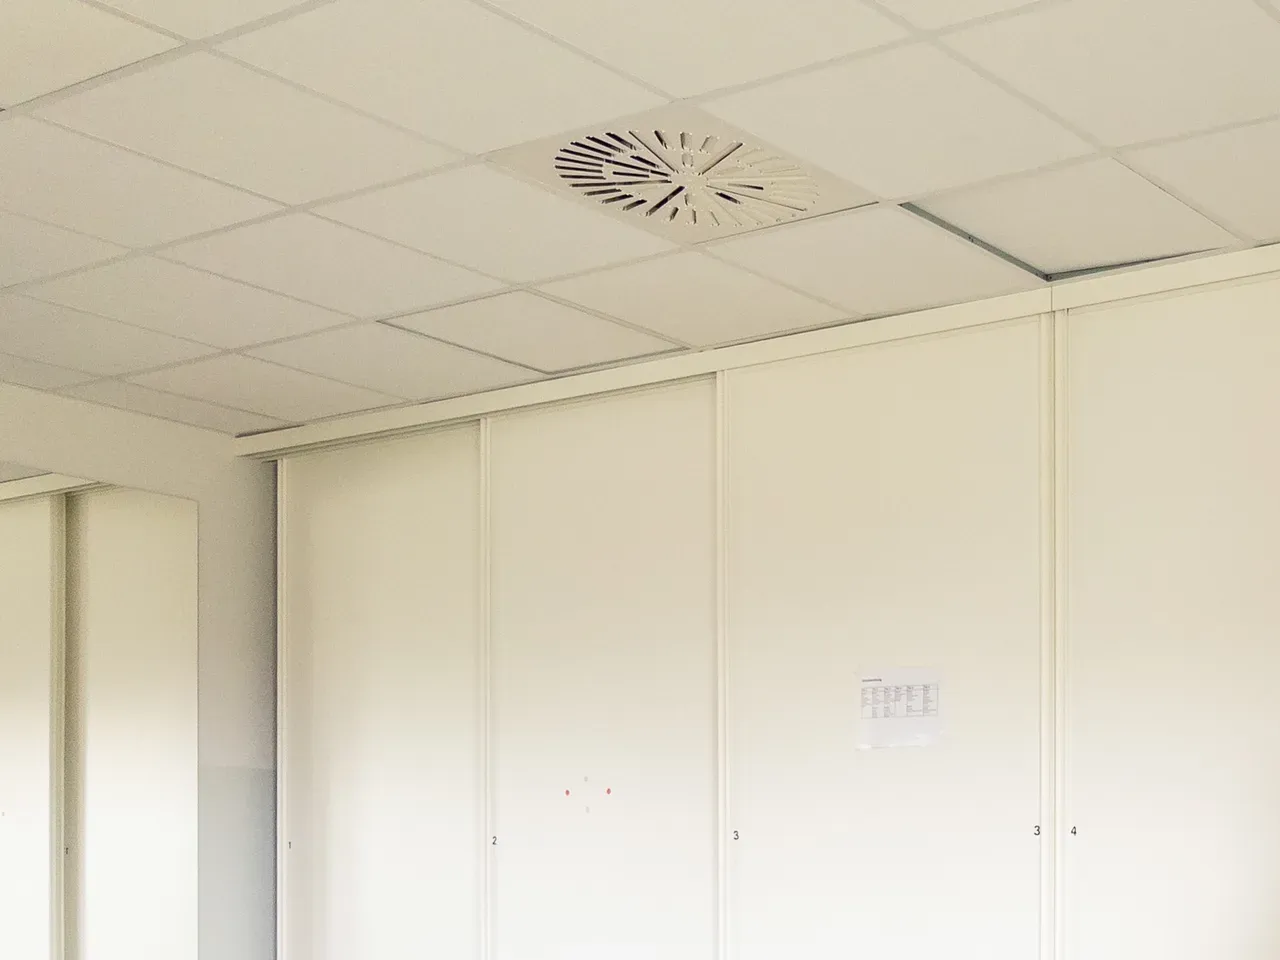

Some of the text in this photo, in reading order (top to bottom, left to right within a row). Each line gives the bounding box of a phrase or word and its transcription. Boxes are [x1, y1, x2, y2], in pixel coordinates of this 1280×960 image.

[733, 830, 740, 841] 3
[1033, 825, 1041, 836] 3
[1070, 825, 1077, 836] 4
[492, 835, 497, 846] 2
